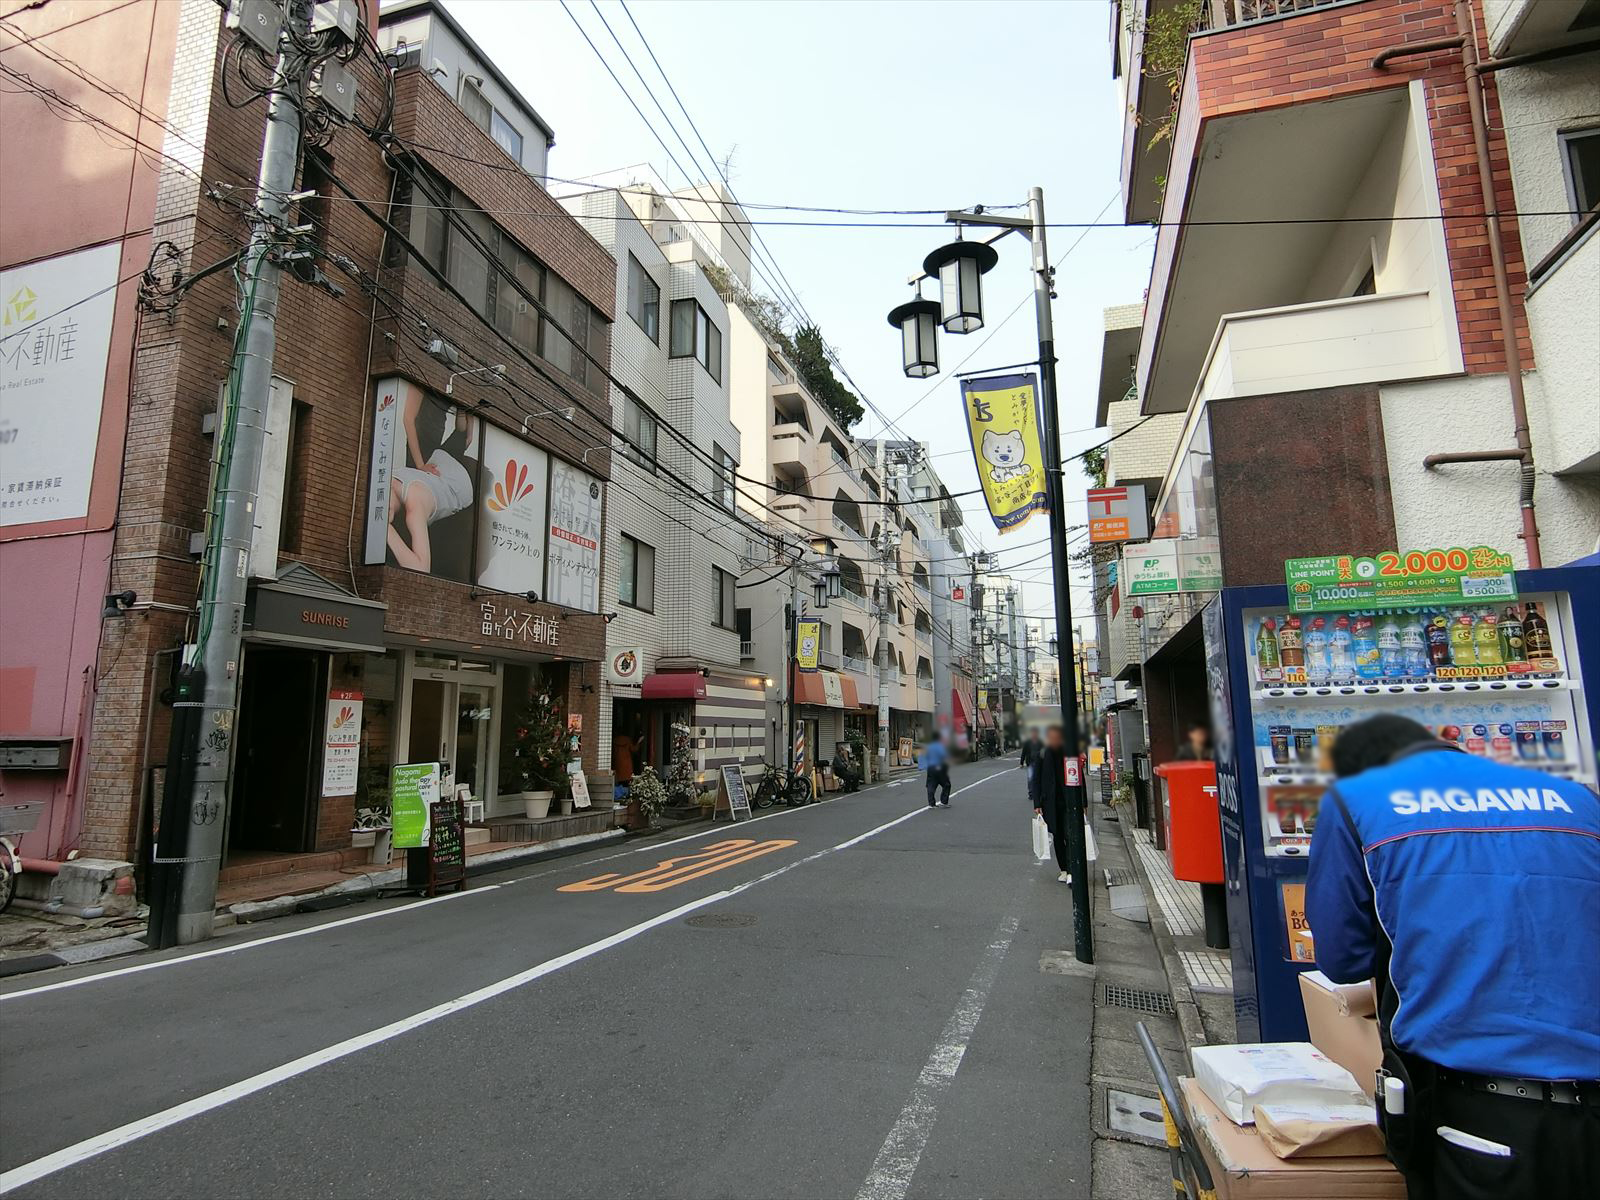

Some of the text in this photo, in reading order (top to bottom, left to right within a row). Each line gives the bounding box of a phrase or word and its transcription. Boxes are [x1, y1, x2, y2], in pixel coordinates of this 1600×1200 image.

[0, 317, 79, 371] 不動産
[1379, 550, 1468, 577] 2,000
[1290, 569, 1336, 579] LINE POINT
[302, 611, 350, 629] SUNRISE
[1437, 668, 1457, 678] 120
[1461, 667, 1480, 677] 120
[1485, 666, 1505, 676] 120
[1287, 673, 1305, 683] 110
[395, 769, 421, 778] Nagomi
[1390, 787, 1574, 815] SAGAWA
